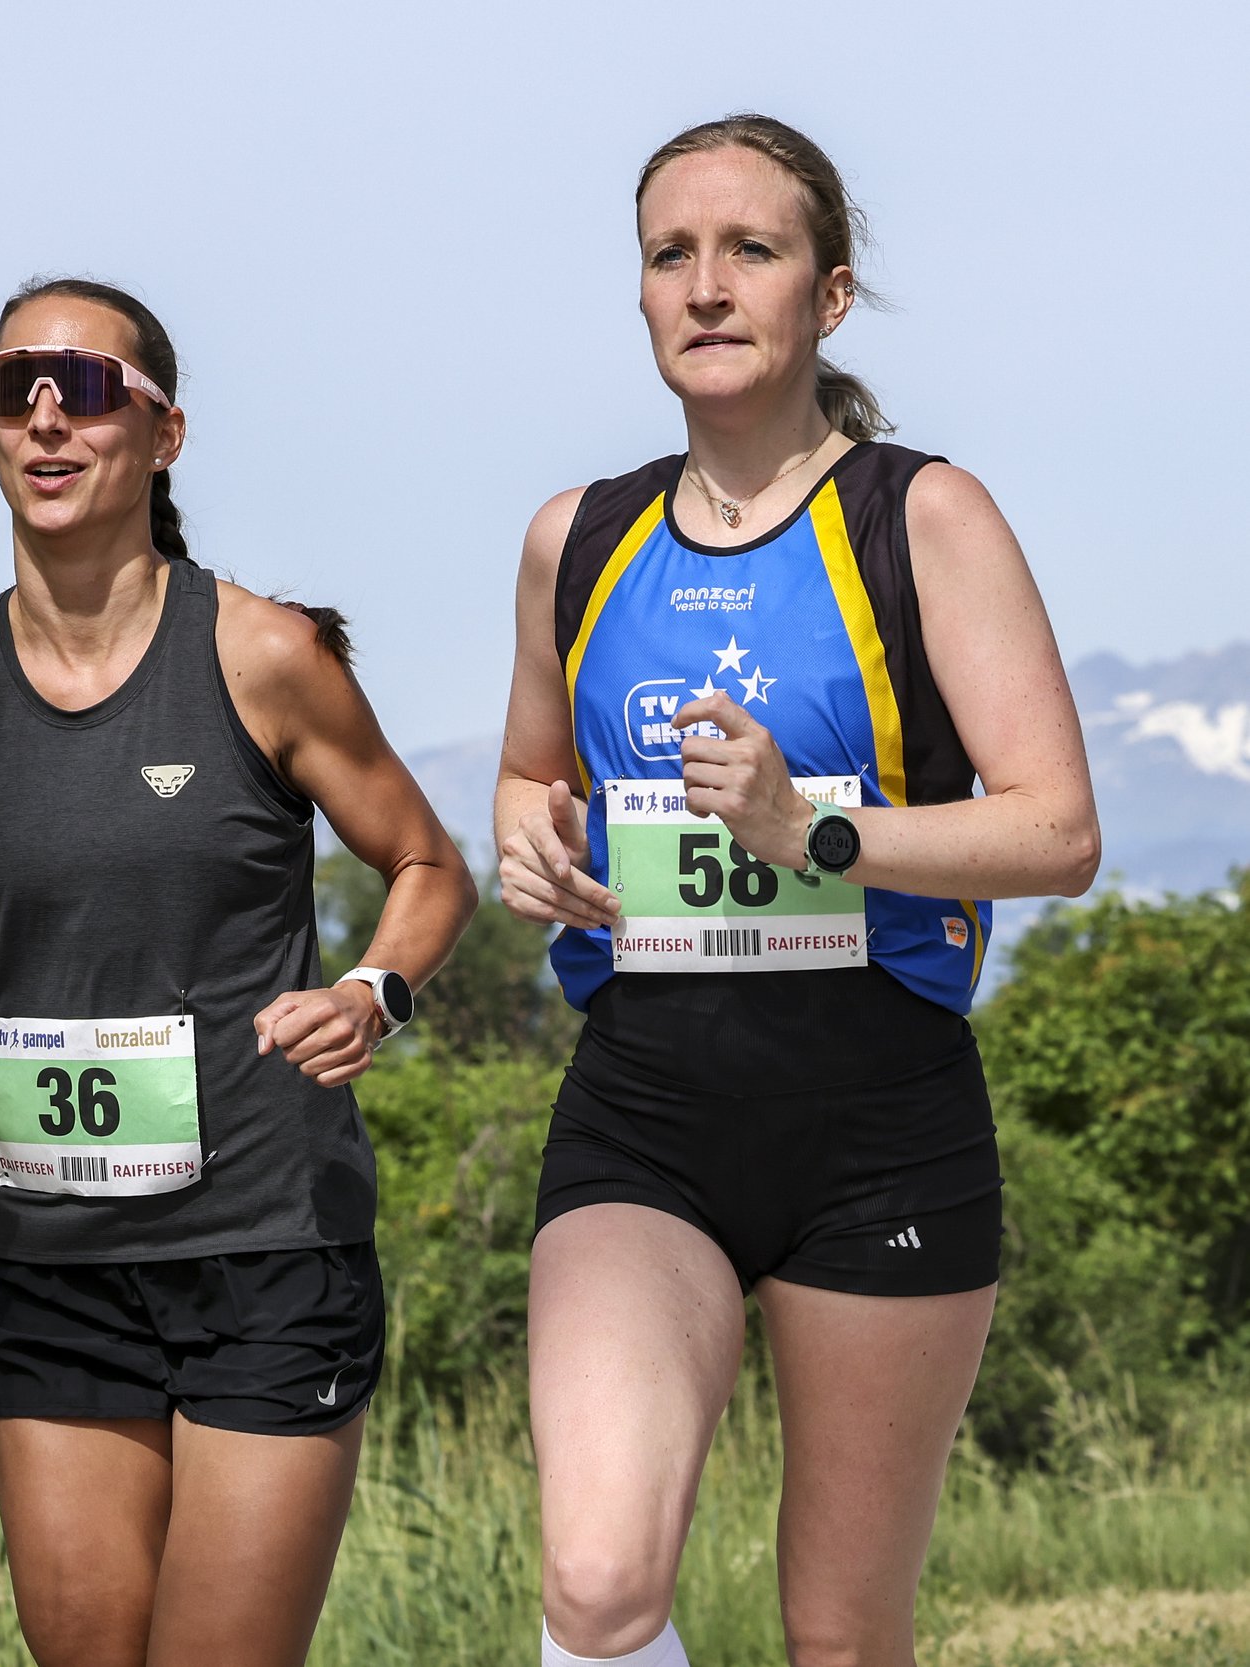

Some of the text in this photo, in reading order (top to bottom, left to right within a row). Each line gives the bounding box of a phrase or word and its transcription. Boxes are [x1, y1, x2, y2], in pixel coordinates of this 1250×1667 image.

[670, 583, 756, 605] panzeri
[675, 600, 752, 612] veste lo sport
[640, 695, 679, 717] TV
[624, 791, 644, 811] stv
[678, 833, 779, 908] 58
[616, 937, 693, 952] RAIFFEISEN
[767, 934, 858, 951] RAIFFEISEN
[22, 1030, 65, 1050] gampel
[95, 1025, 172, 1049] lonzalauf
[36, 1066, 121, 1137] 36
[0, 1156, 55, 1177] RAIFFEISEN
[112, 1160, 195, 1178] RAIFFEISEN
